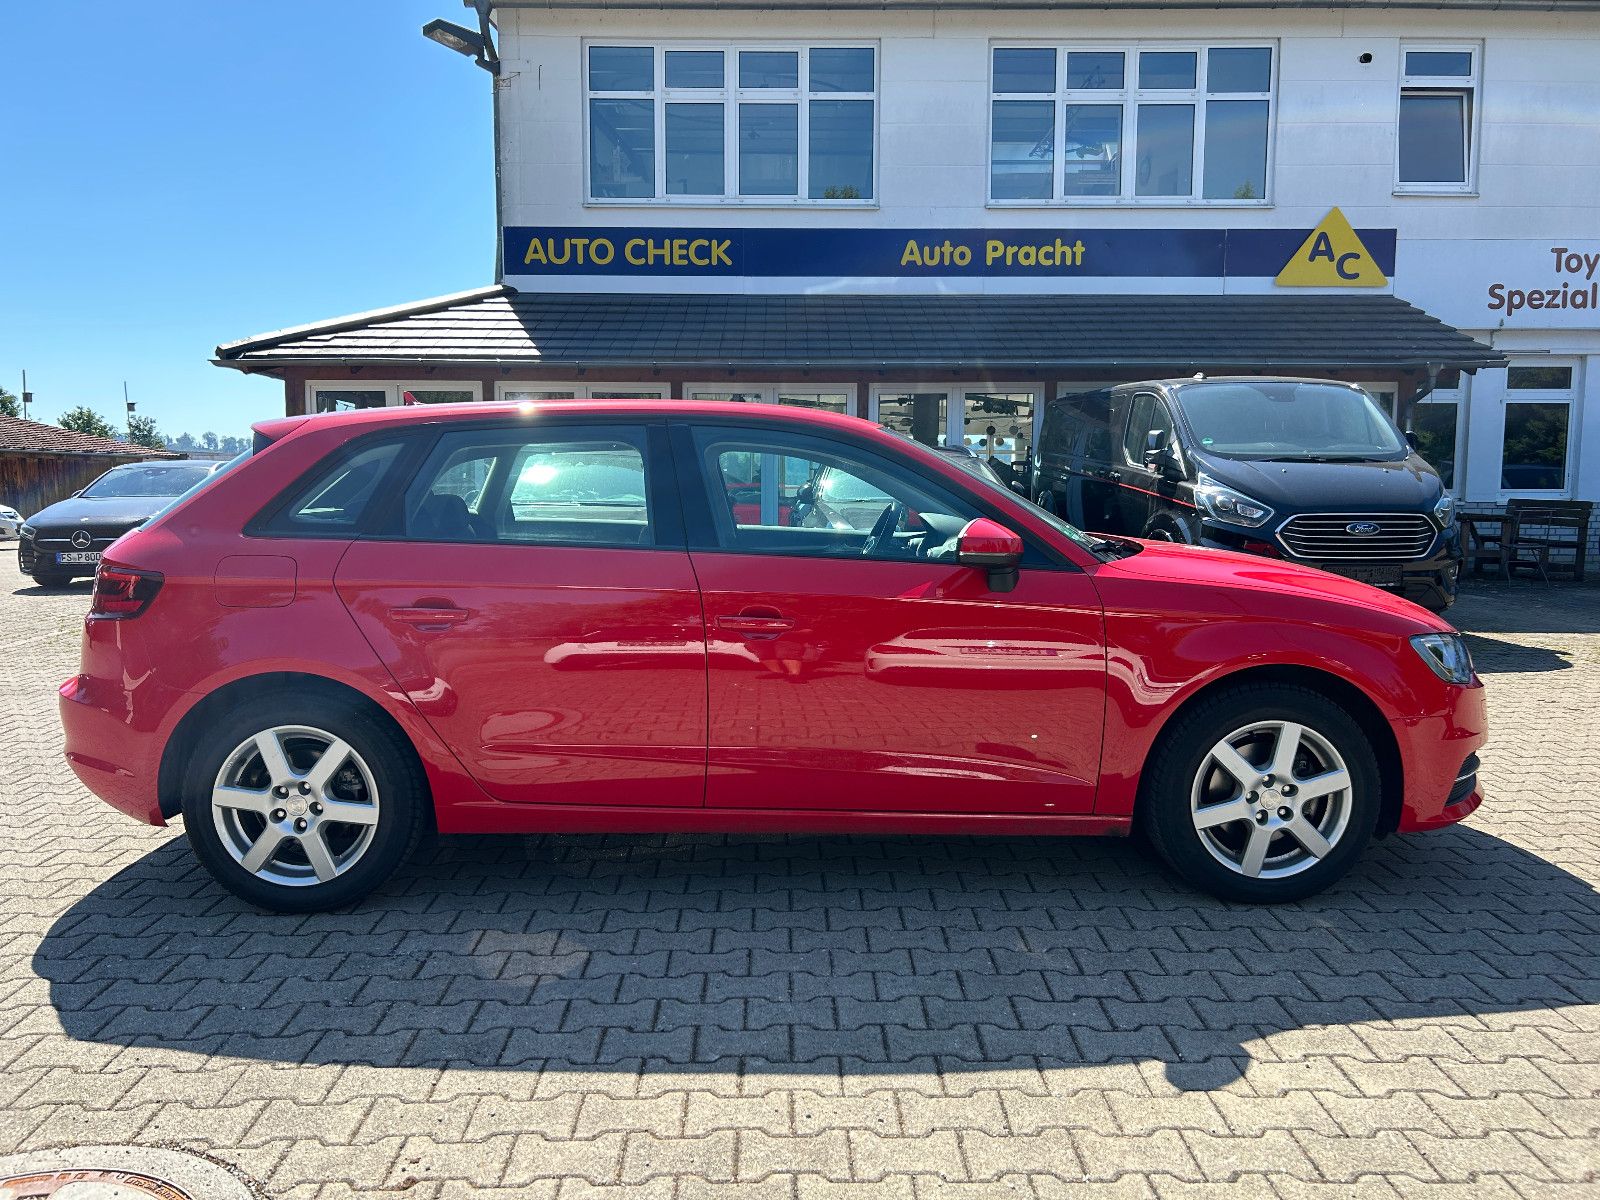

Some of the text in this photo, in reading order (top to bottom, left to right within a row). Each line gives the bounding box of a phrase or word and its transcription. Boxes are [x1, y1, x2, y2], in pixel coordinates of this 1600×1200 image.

[524, 238, 733, 266] AUTO CHECK
[900, 238, 1086, 266] Auto Pracht
[1487, 281, 1598, 317] Spezial
[61, 554, 72, 562] FS
[78, 554, 83, 562] P
